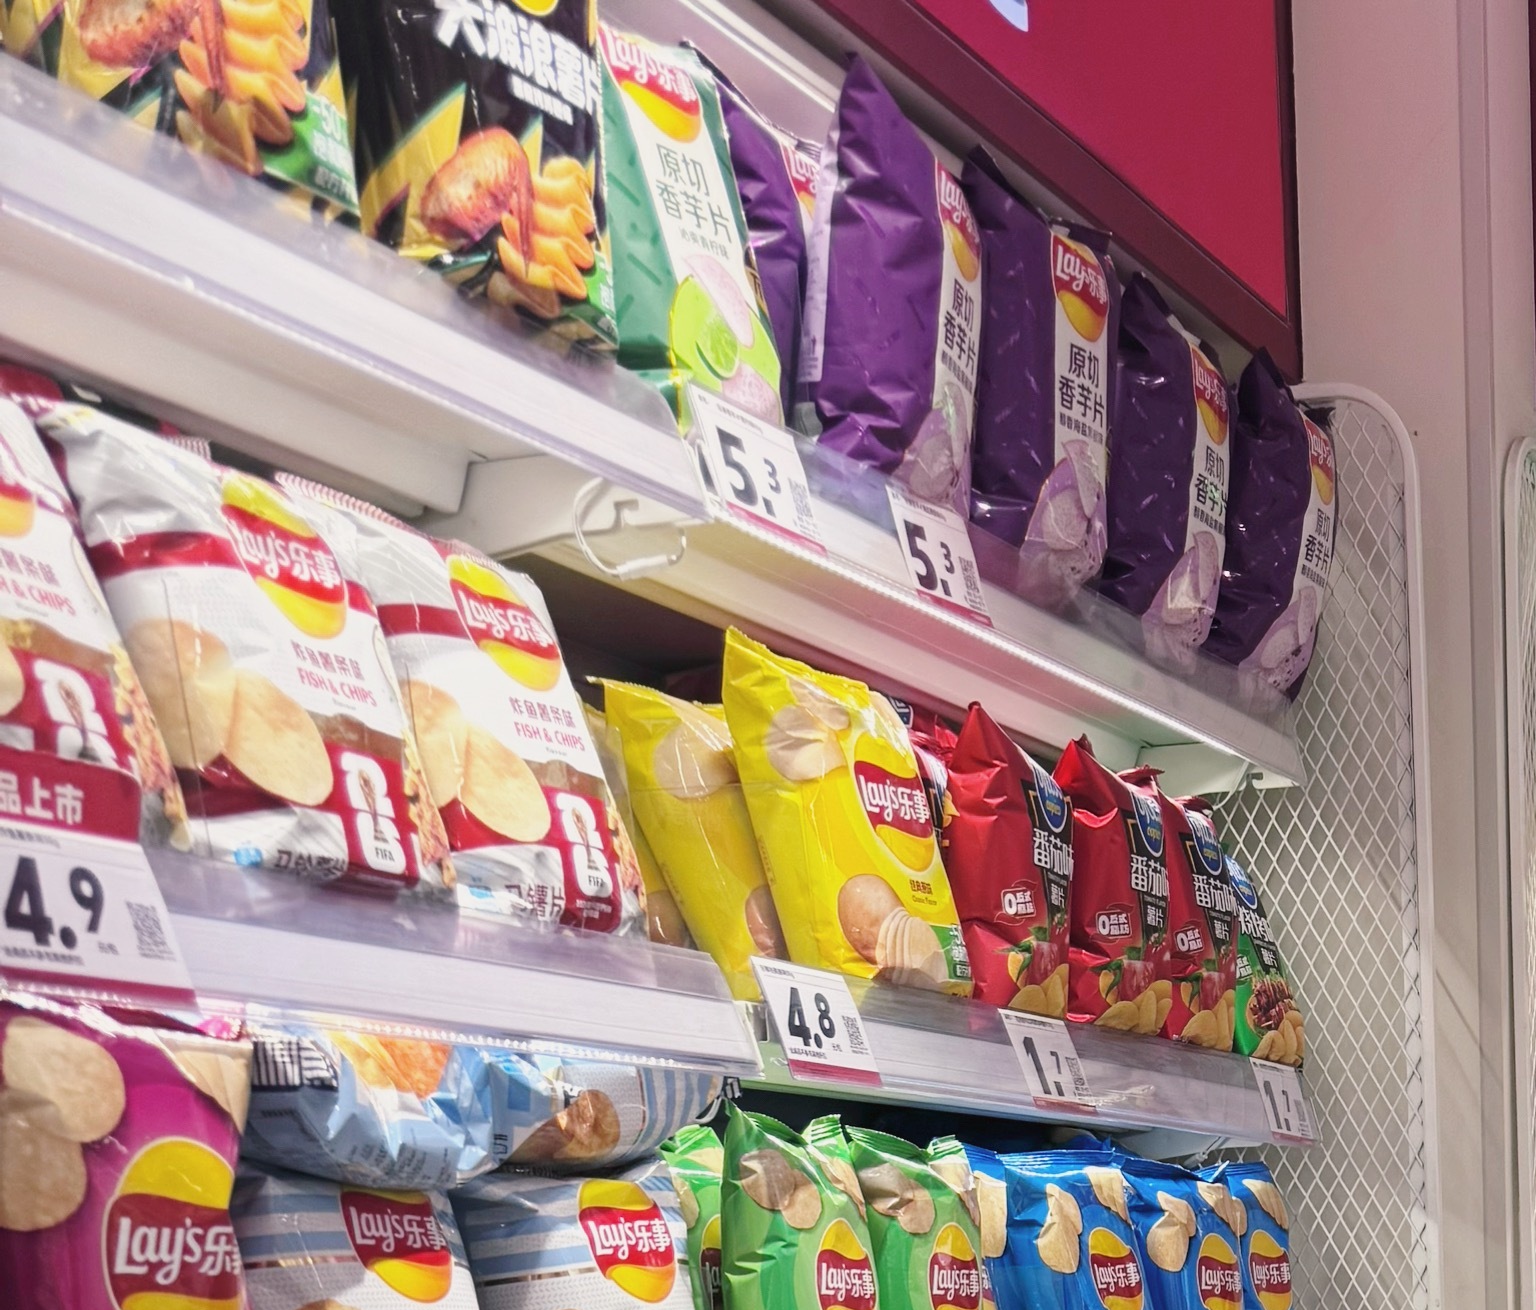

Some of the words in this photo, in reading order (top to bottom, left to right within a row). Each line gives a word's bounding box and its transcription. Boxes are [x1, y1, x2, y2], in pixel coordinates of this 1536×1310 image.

[718, 424, 783, 516] 5.3
[906, 520, 956, 597] 5.3
[513, 720, 543, 740] FISH
[556, 731, 587, 754] CHIPS
[4, 855, 105, 955] 4.9
[787, 986, 836, 1051] 4.8
[1022, 1036, 1064, 1097] 1.7
